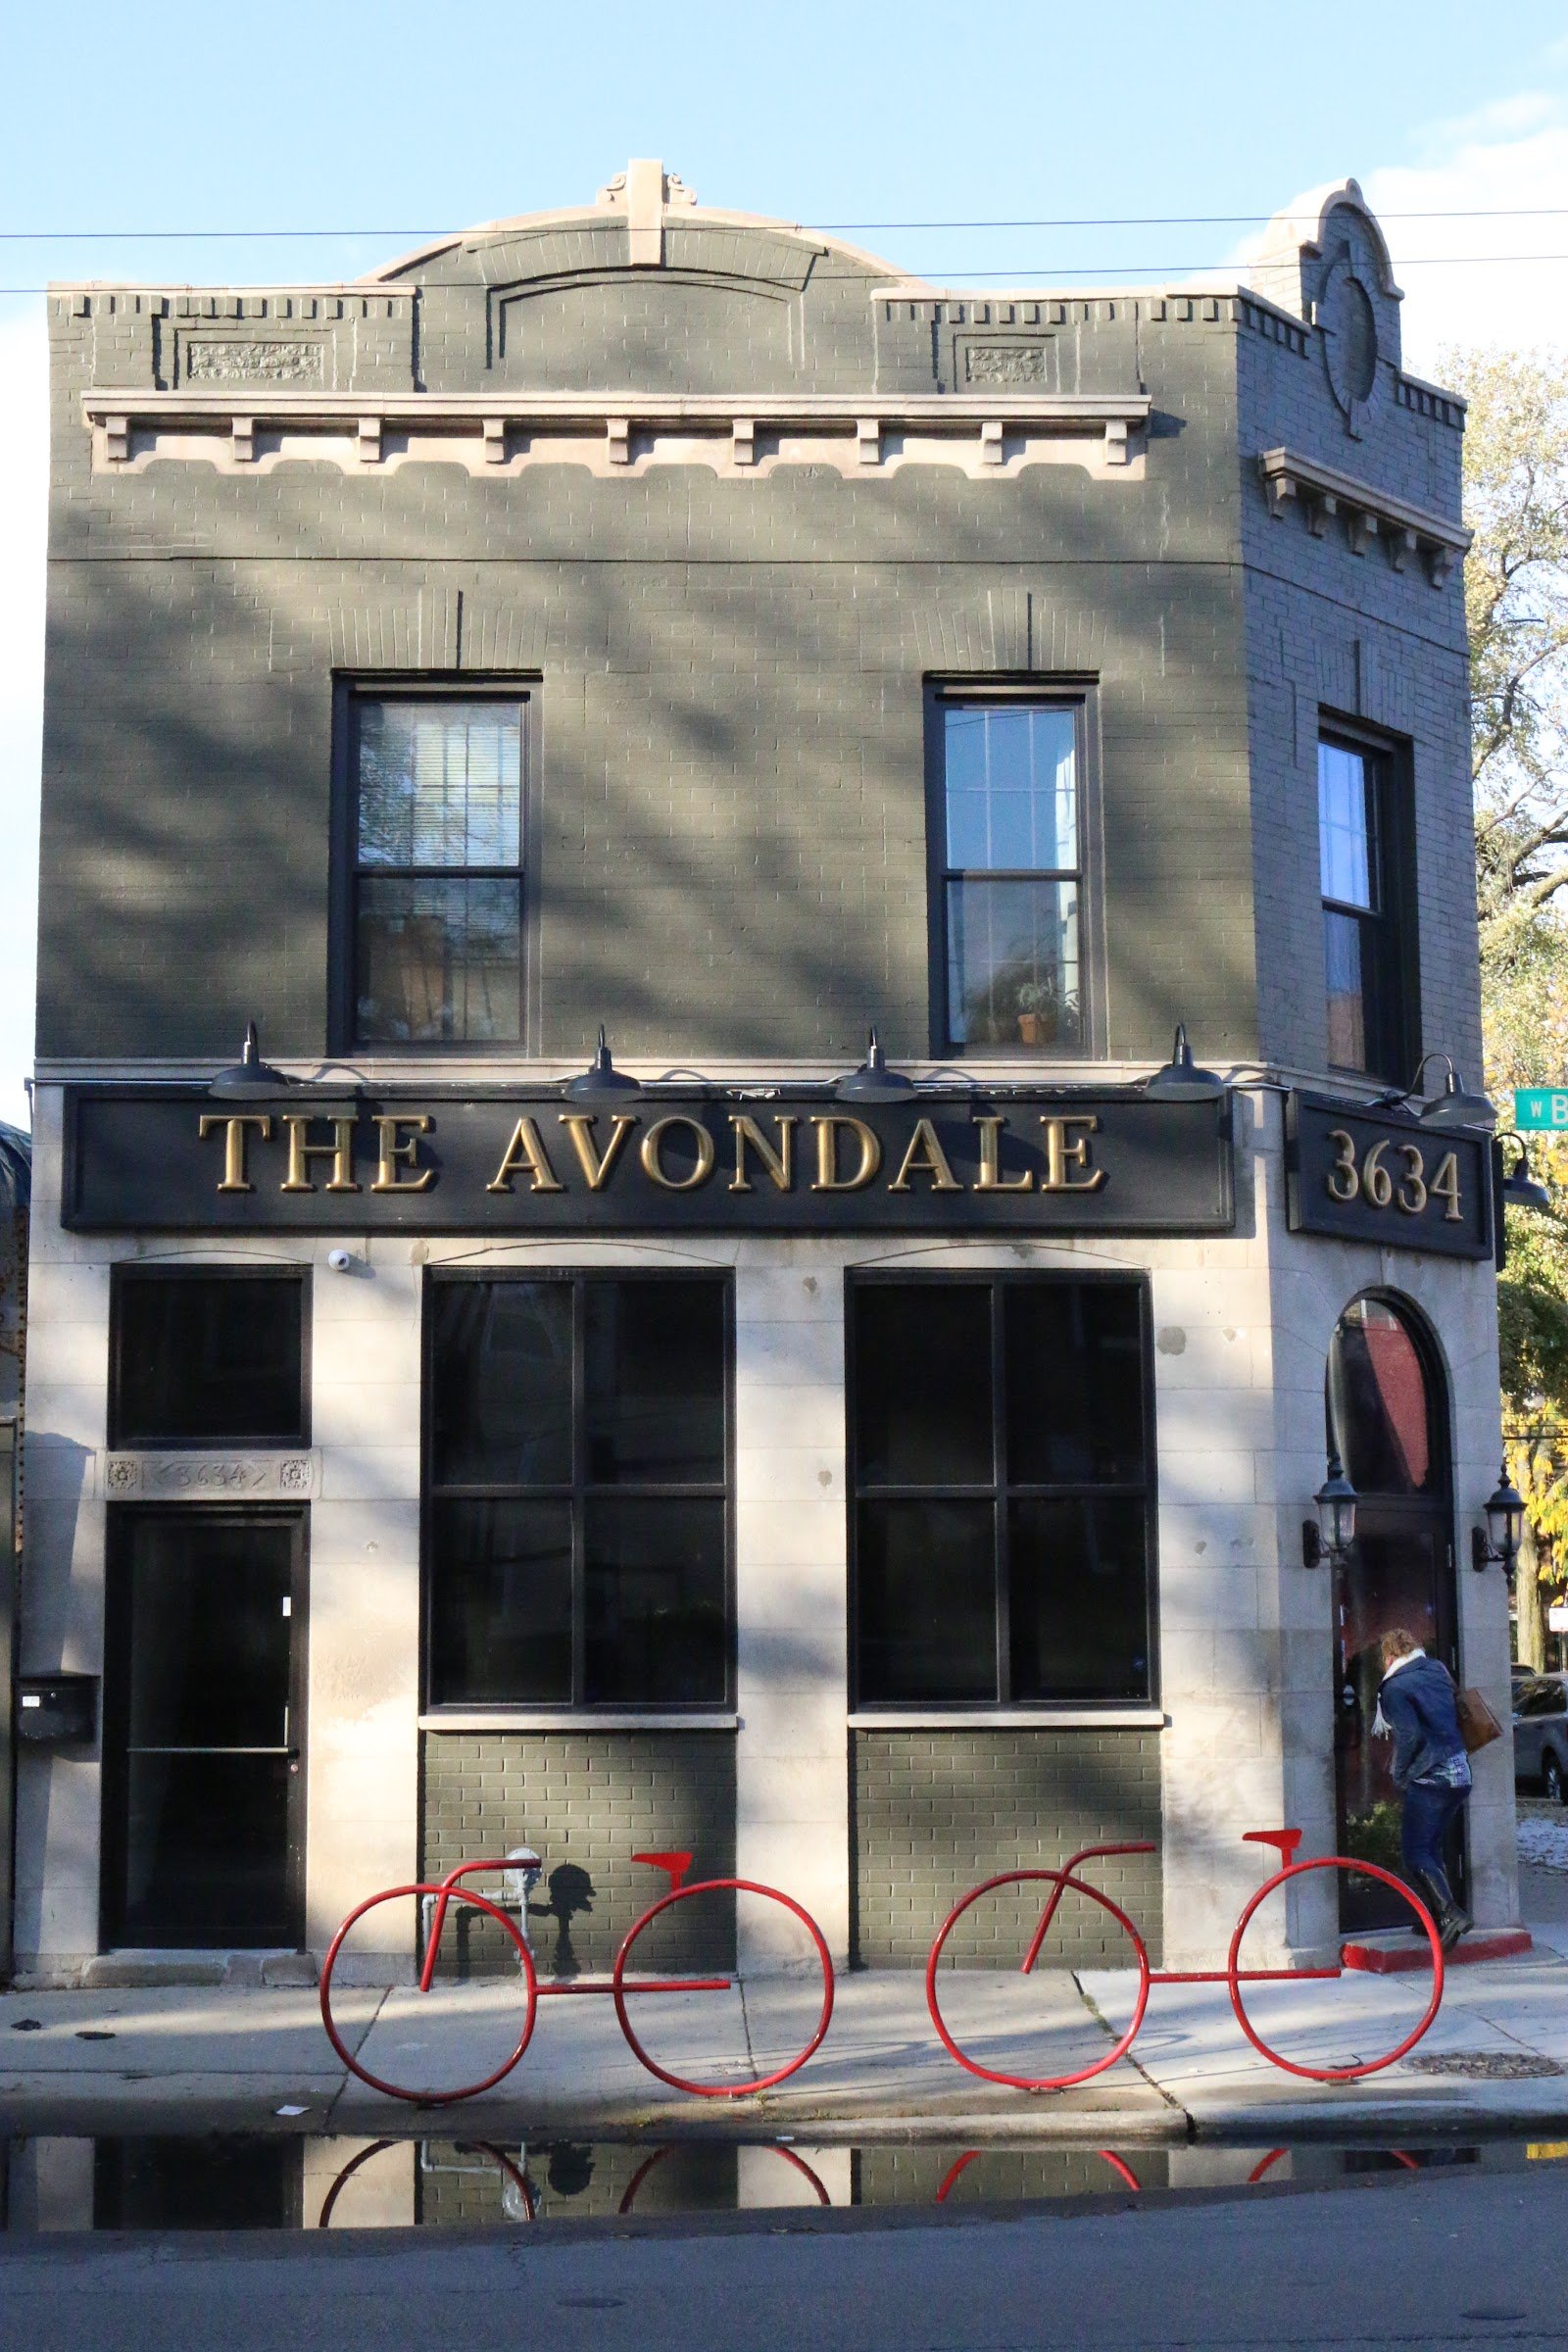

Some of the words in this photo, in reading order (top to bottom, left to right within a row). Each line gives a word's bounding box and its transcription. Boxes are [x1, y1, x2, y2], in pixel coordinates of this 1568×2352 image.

[1530, 1100, 1543, 1118] W
[198, 1114, 436, 1193] THE
[485, 1113, 1103, 1193] AVONDALE
[1327, 1129, 1464, 1222] 3634
[178, 1463, 247, 1488] 3634
